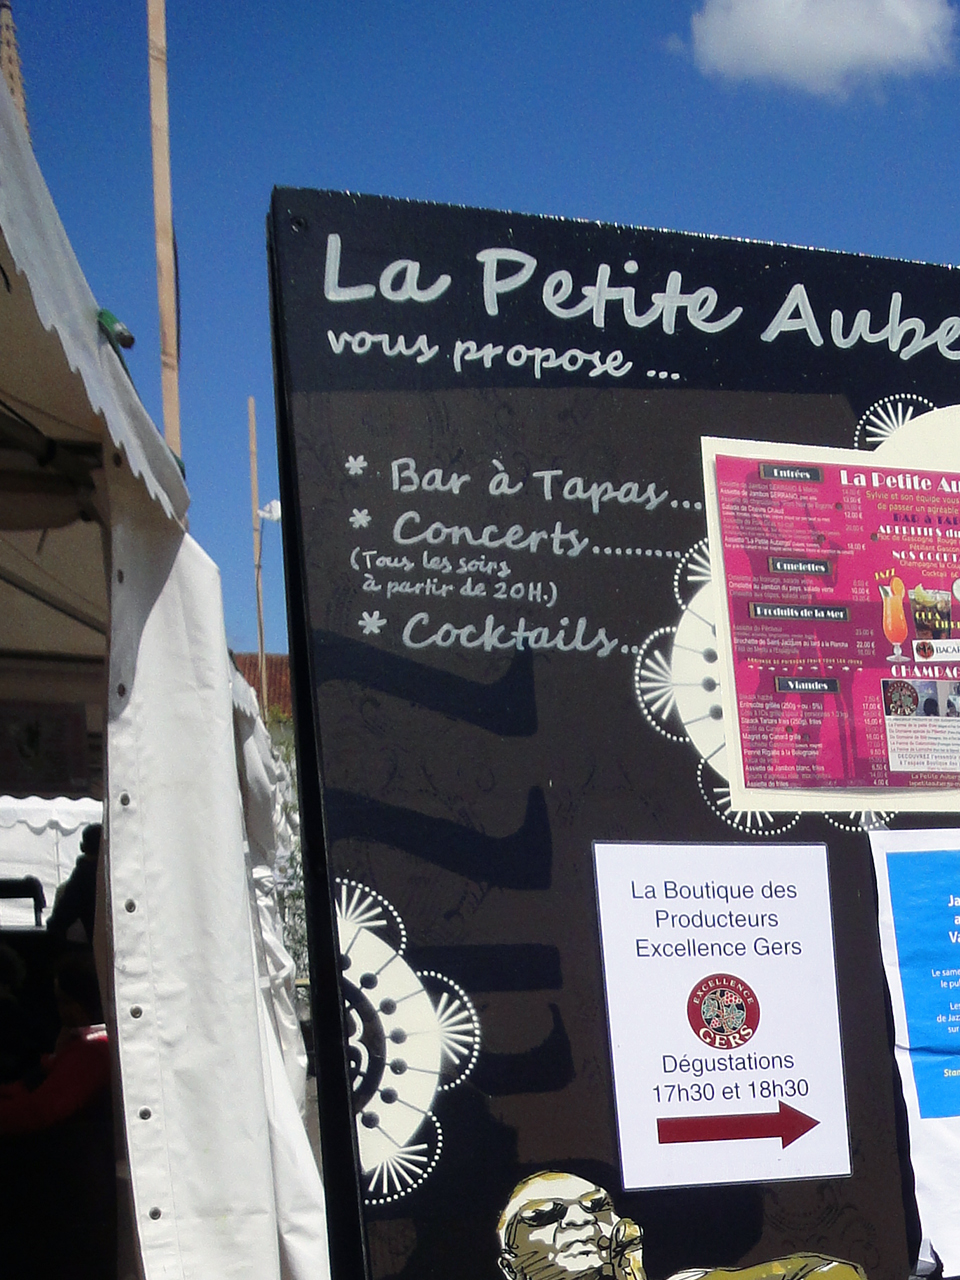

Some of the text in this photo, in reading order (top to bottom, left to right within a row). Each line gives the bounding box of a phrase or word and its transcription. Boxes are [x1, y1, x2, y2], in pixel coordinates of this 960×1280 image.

[325, 233, 451, 303] La
[476, 247, 743, 334] Petite
[327, 329, 633, 379] vous propose
[392, 456, 470, 494] Bar
[489, 459, 521, 496] à
[773, 468, 811, 479] Entrées
[841, 469, 867, 487] La
[871, 472, 932, 491] Petite
[350, 545, 511, 577] (Tous les soirs
[362, 573, 383, 593] à
[386, 575, 454, 599] partir
[460, 578, 487, 598] de
[756, 606, 845, 619] Produits de la Mer
[788, 680, 828, 690] Viandes
[631, 880, 797, 904] La Boutique des
[655, 909, 779, 928] Producteurs
[635, 937, 802, 957] Excellence Gers
[931, 968, 941, 977] Le
[940, 979, 948, 988] le
[693, 978, 755, 1005] EXCELLENCE
[936, 1014, 946, 1023] de
[699, 1024, 754, 1049] GERS
[662, 1052, 794, 1076] Dégustations
[652, 1078, 810, 1103] 17h30 et 18h30
